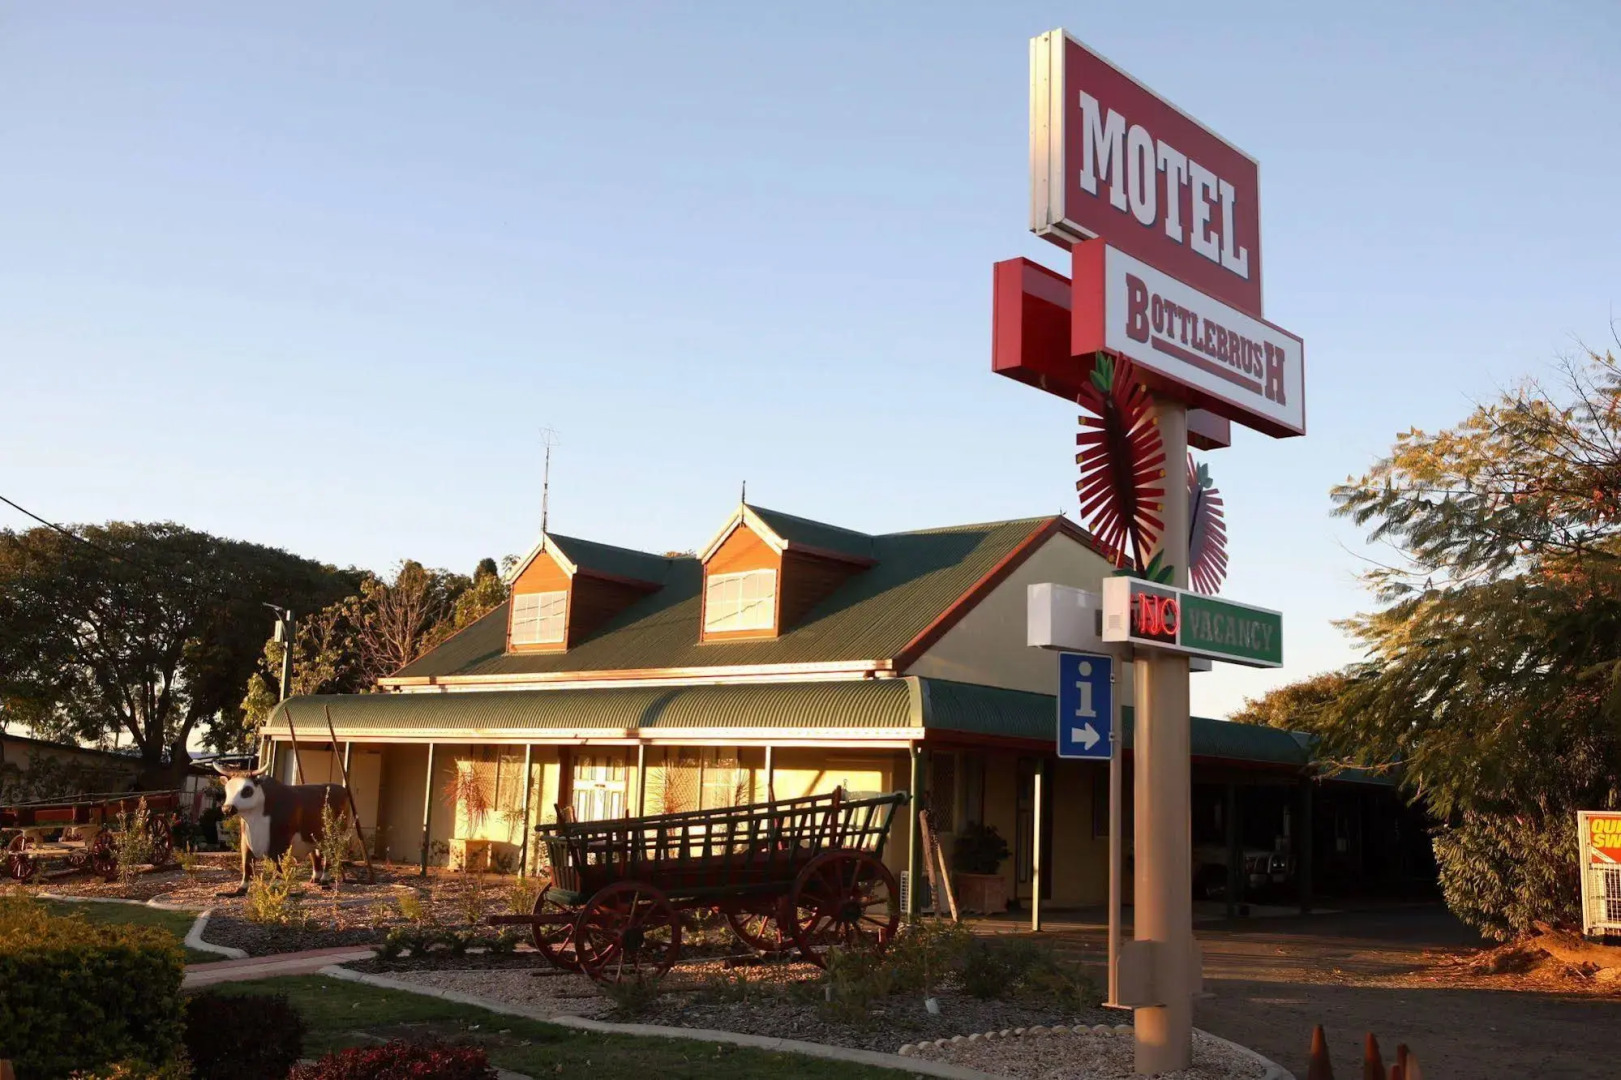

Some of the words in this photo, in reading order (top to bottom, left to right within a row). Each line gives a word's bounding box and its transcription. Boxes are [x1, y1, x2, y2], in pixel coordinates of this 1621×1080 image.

[1079, 89, 1249, 280] MOTEL
[1125, 272, 1286, 407] BOTTLEBRUSH
[1136, 592, 1180, 636] NO
[1189, 608, 1274, 650] VACANCY
